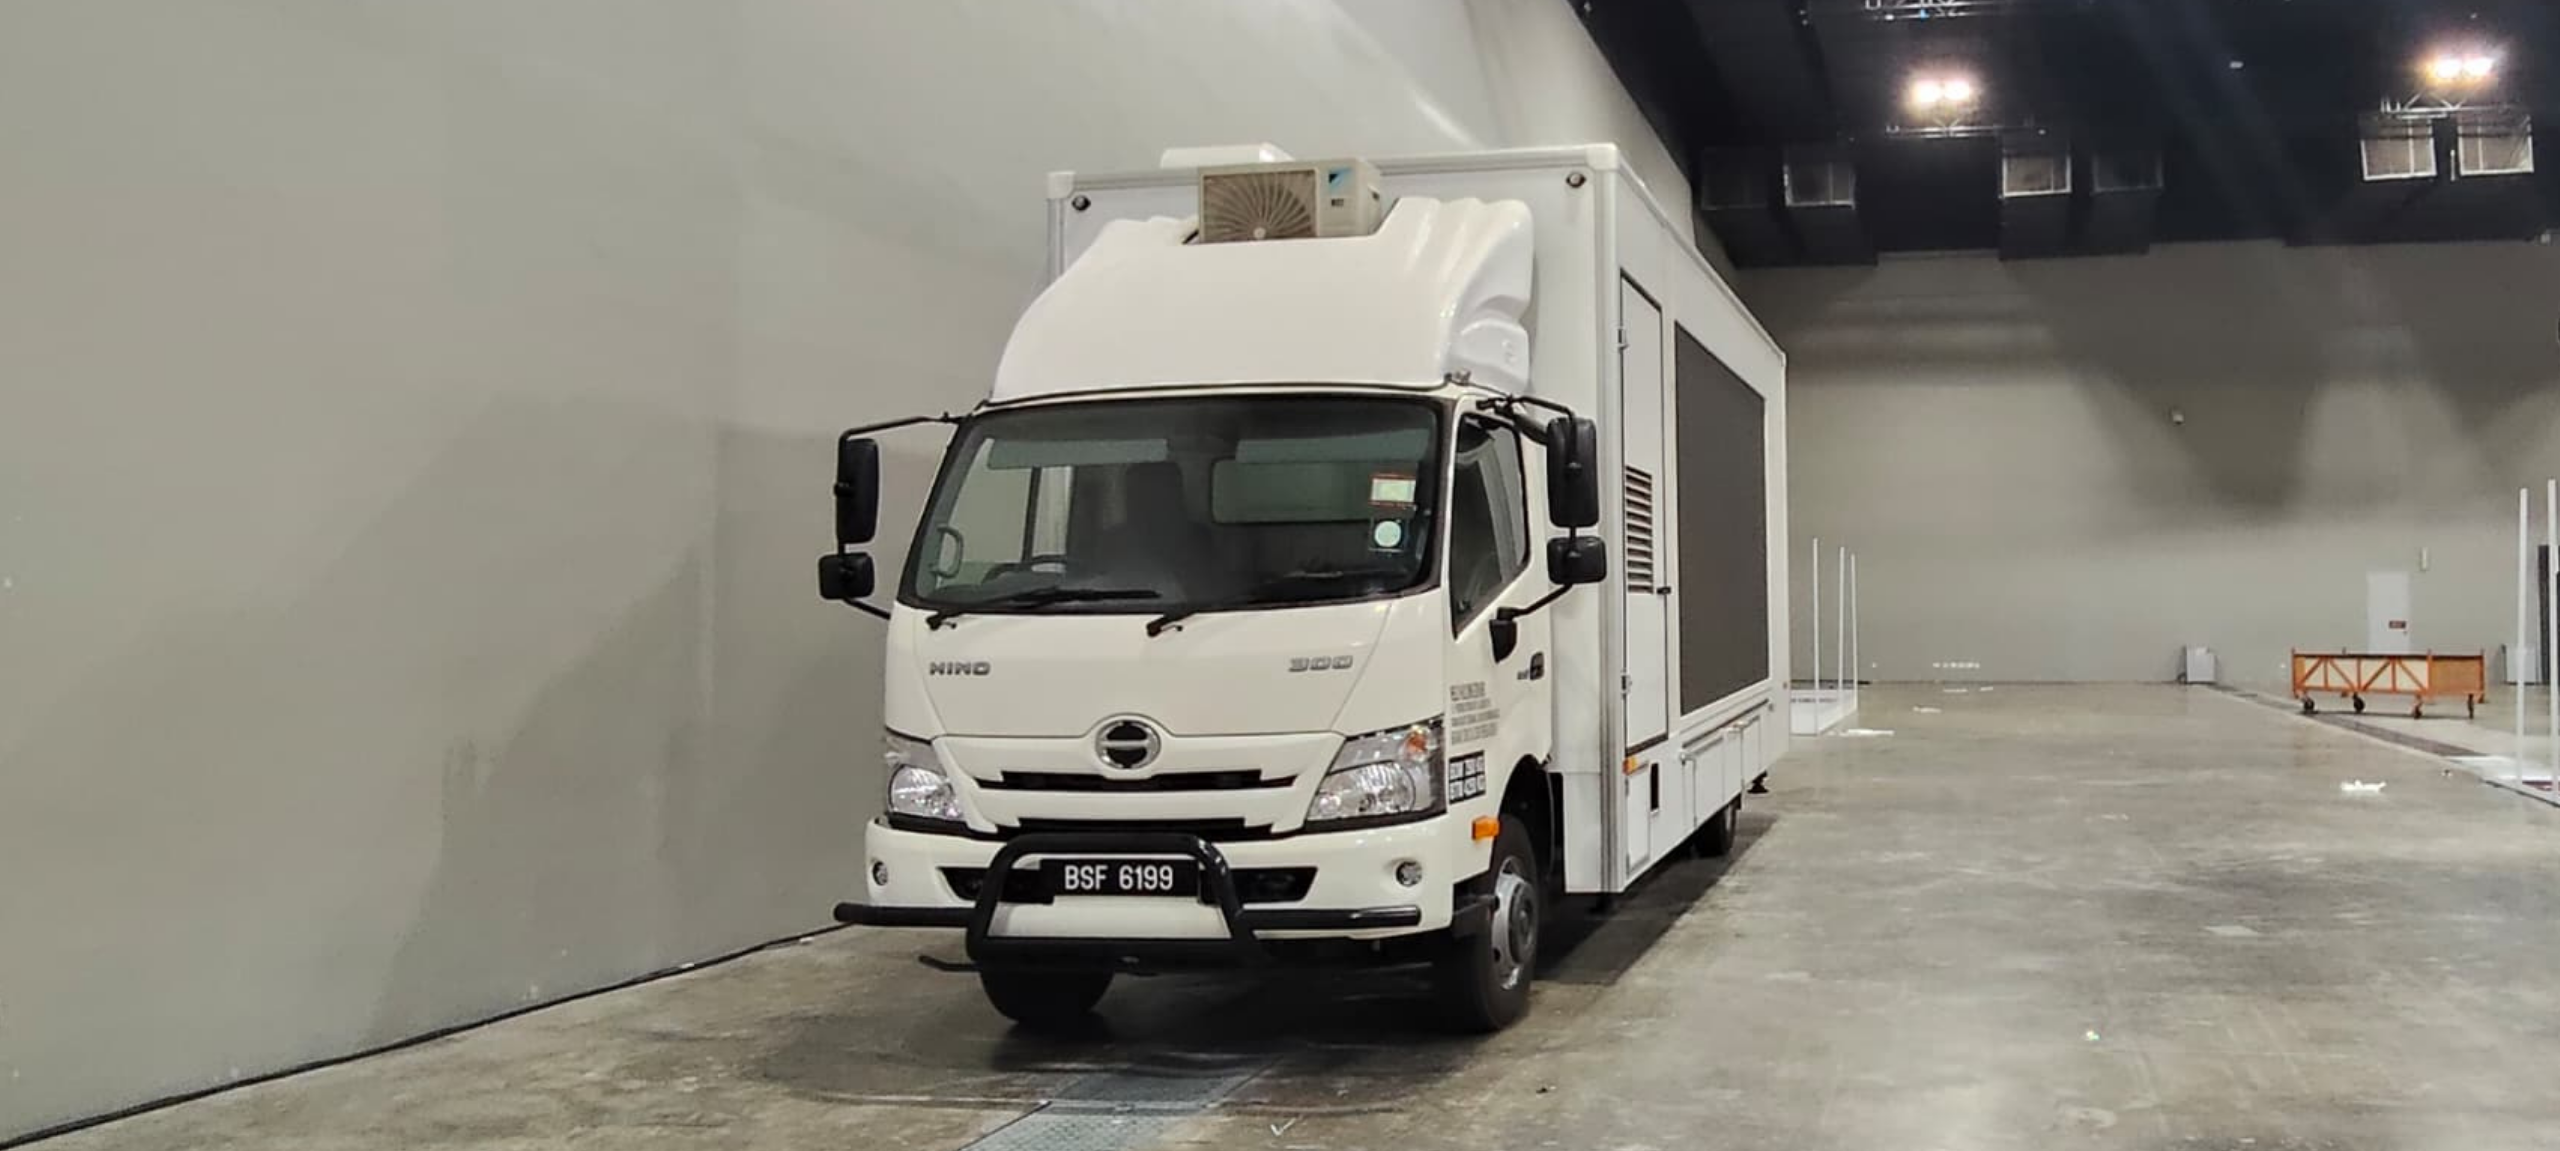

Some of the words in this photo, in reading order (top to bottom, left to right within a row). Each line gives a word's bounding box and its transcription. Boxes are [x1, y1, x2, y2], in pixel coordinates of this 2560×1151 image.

[930, 661, 990, 675] HINO
[1289, 655, 1353, 672] 300
[1065, 865, 1108, 890] BSF
[1119, 865, 1173, 890] 6199
